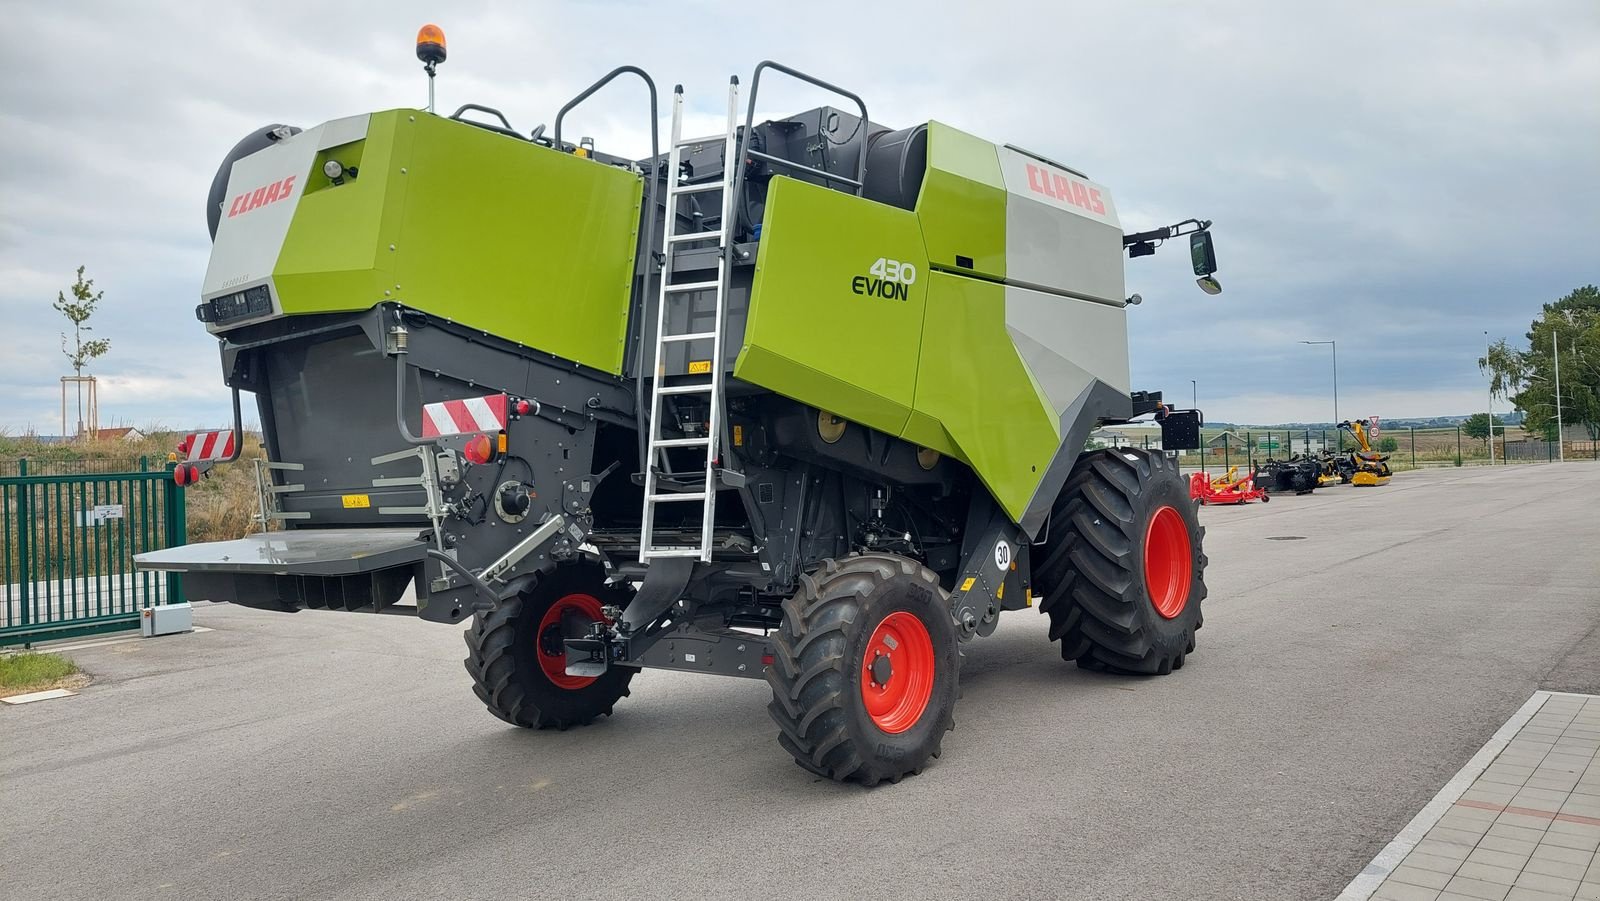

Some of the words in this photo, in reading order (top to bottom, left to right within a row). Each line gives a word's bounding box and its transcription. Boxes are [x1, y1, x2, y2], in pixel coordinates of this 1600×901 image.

[227, 175, 296, 218] CLAAS
[1026, 163, 1105, 216] CLAAS
[870, 257, 916, 285] 430
[852, 276, 908, 301] EVION
[997, 545, 1008, 565] 30
